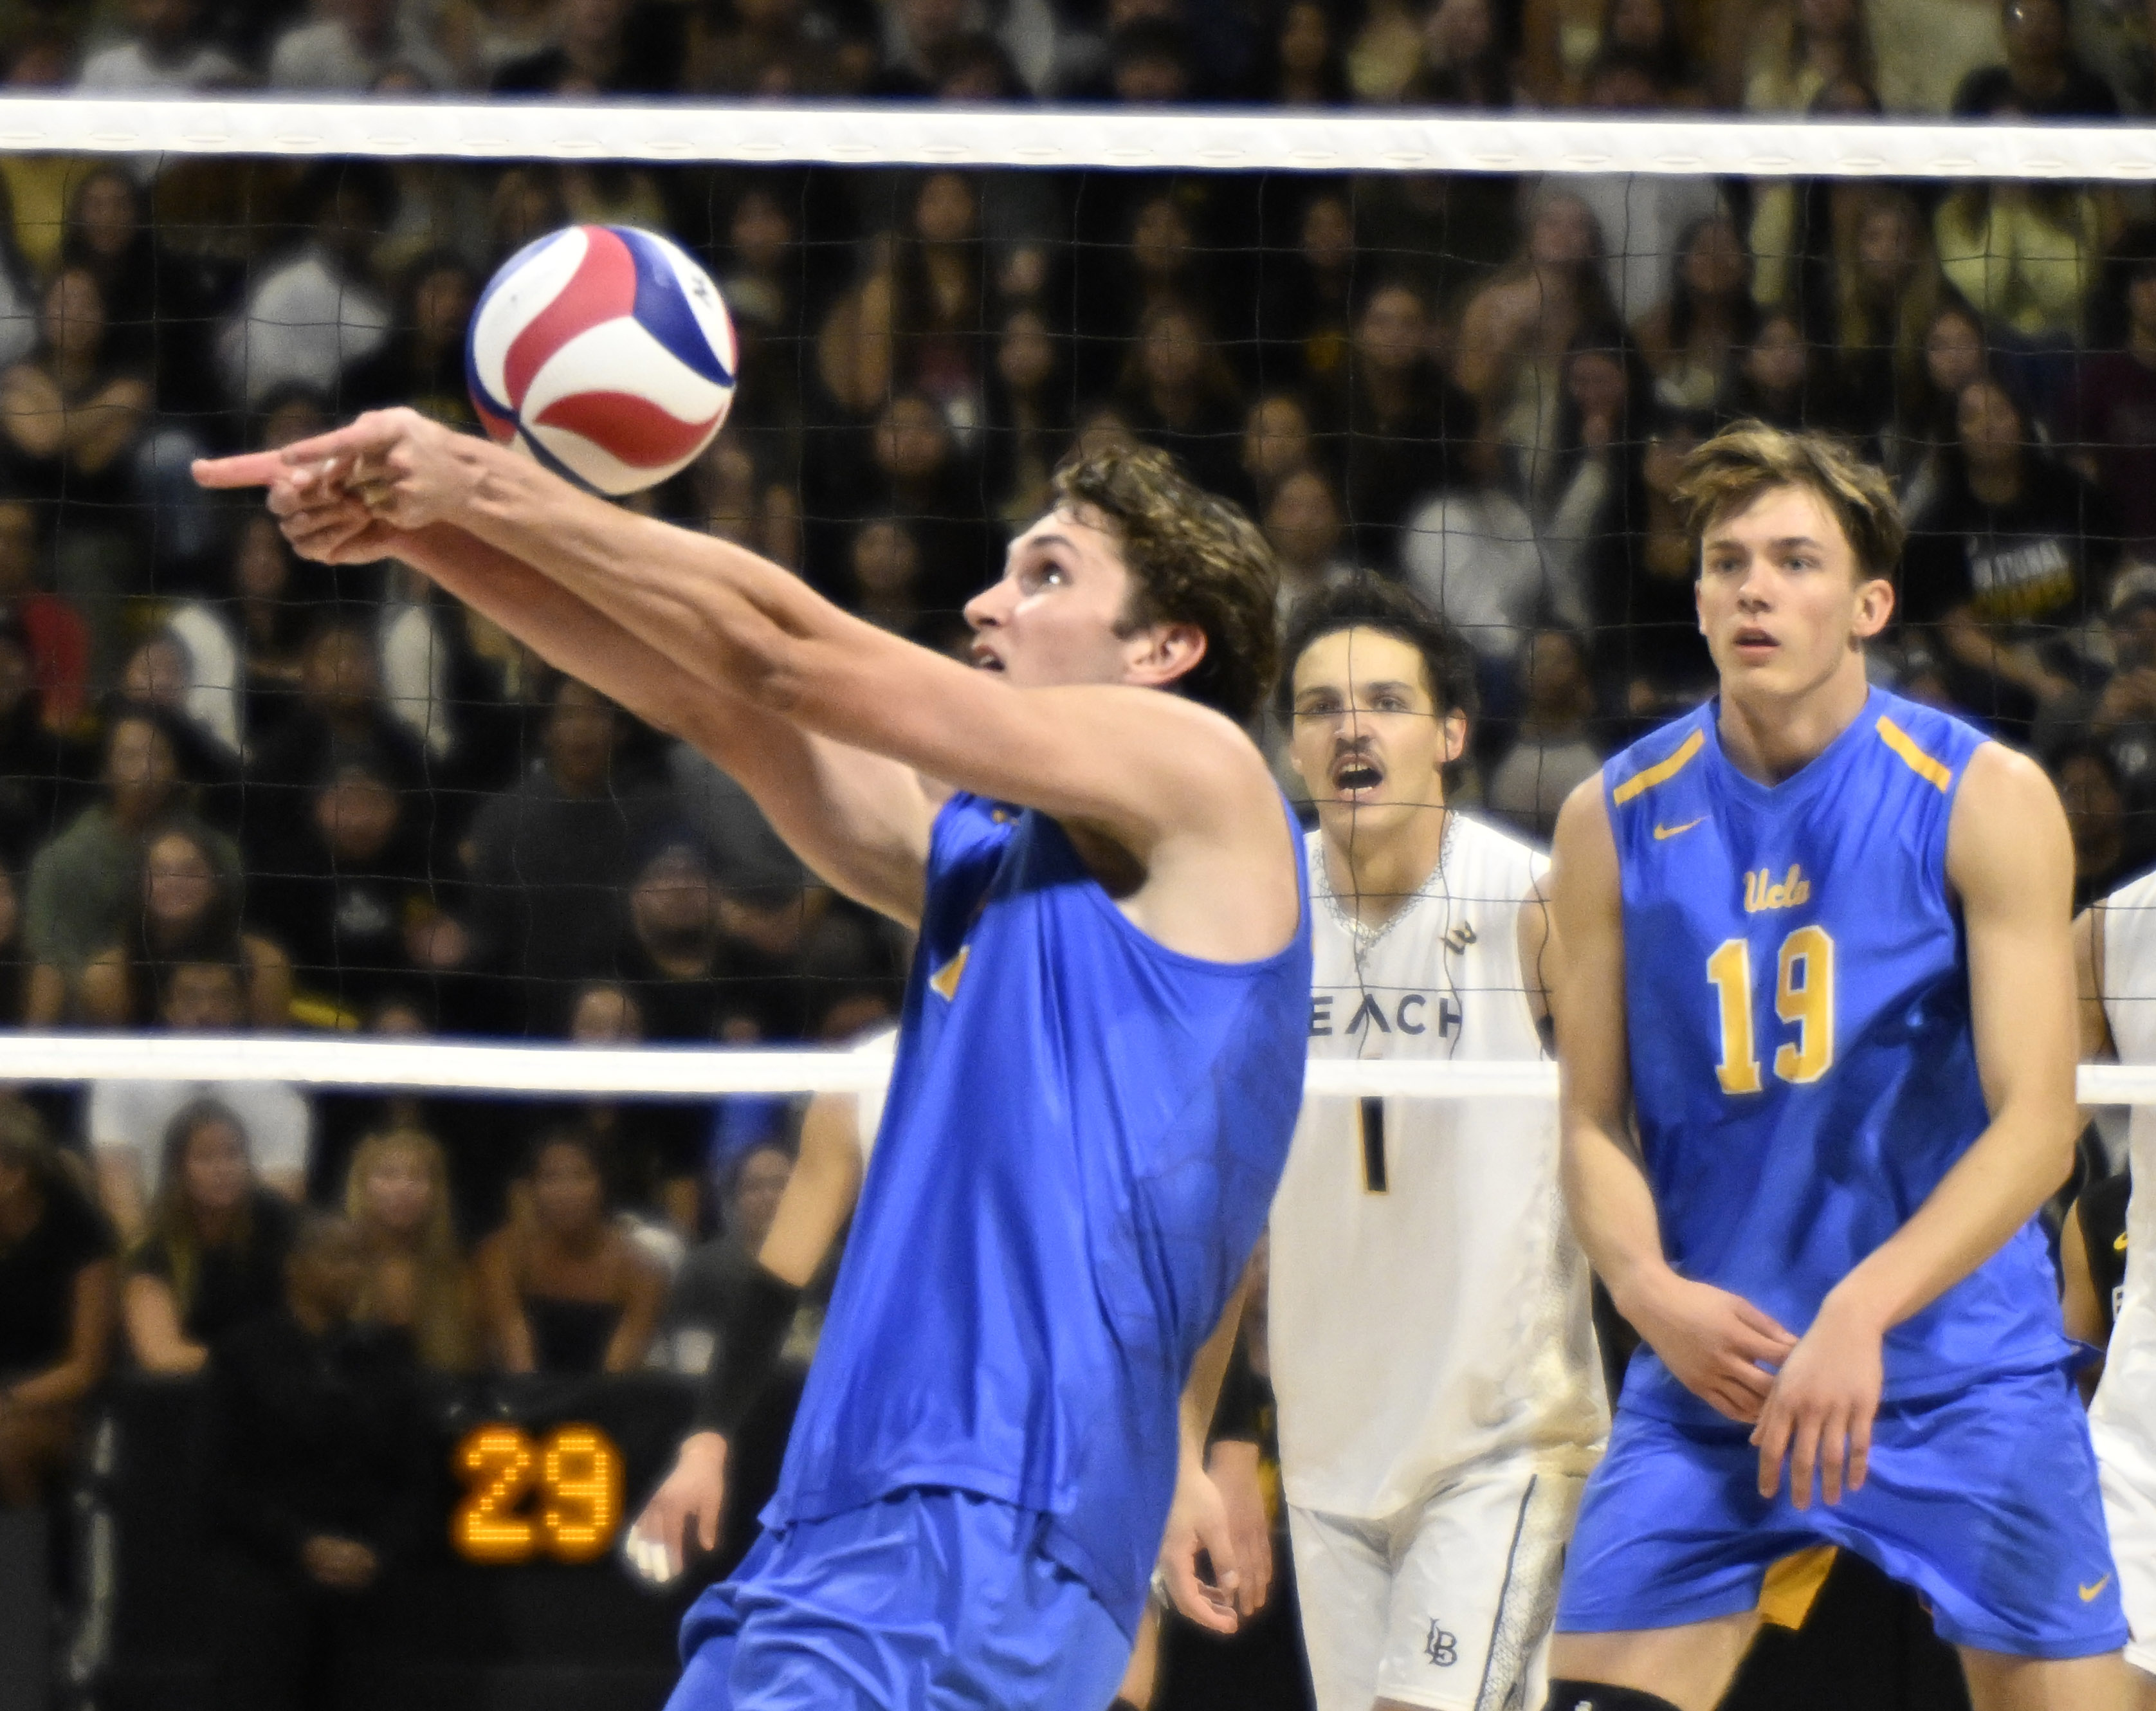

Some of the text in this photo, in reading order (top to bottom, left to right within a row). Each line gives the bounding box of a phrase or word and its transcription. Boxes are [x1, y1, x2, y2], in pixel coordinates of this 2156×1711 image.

[1706, 925, 1835, 1095] 19
[1357, 1055, 1389, 1195] 1
[466, 1434, 610, 1544] 29
